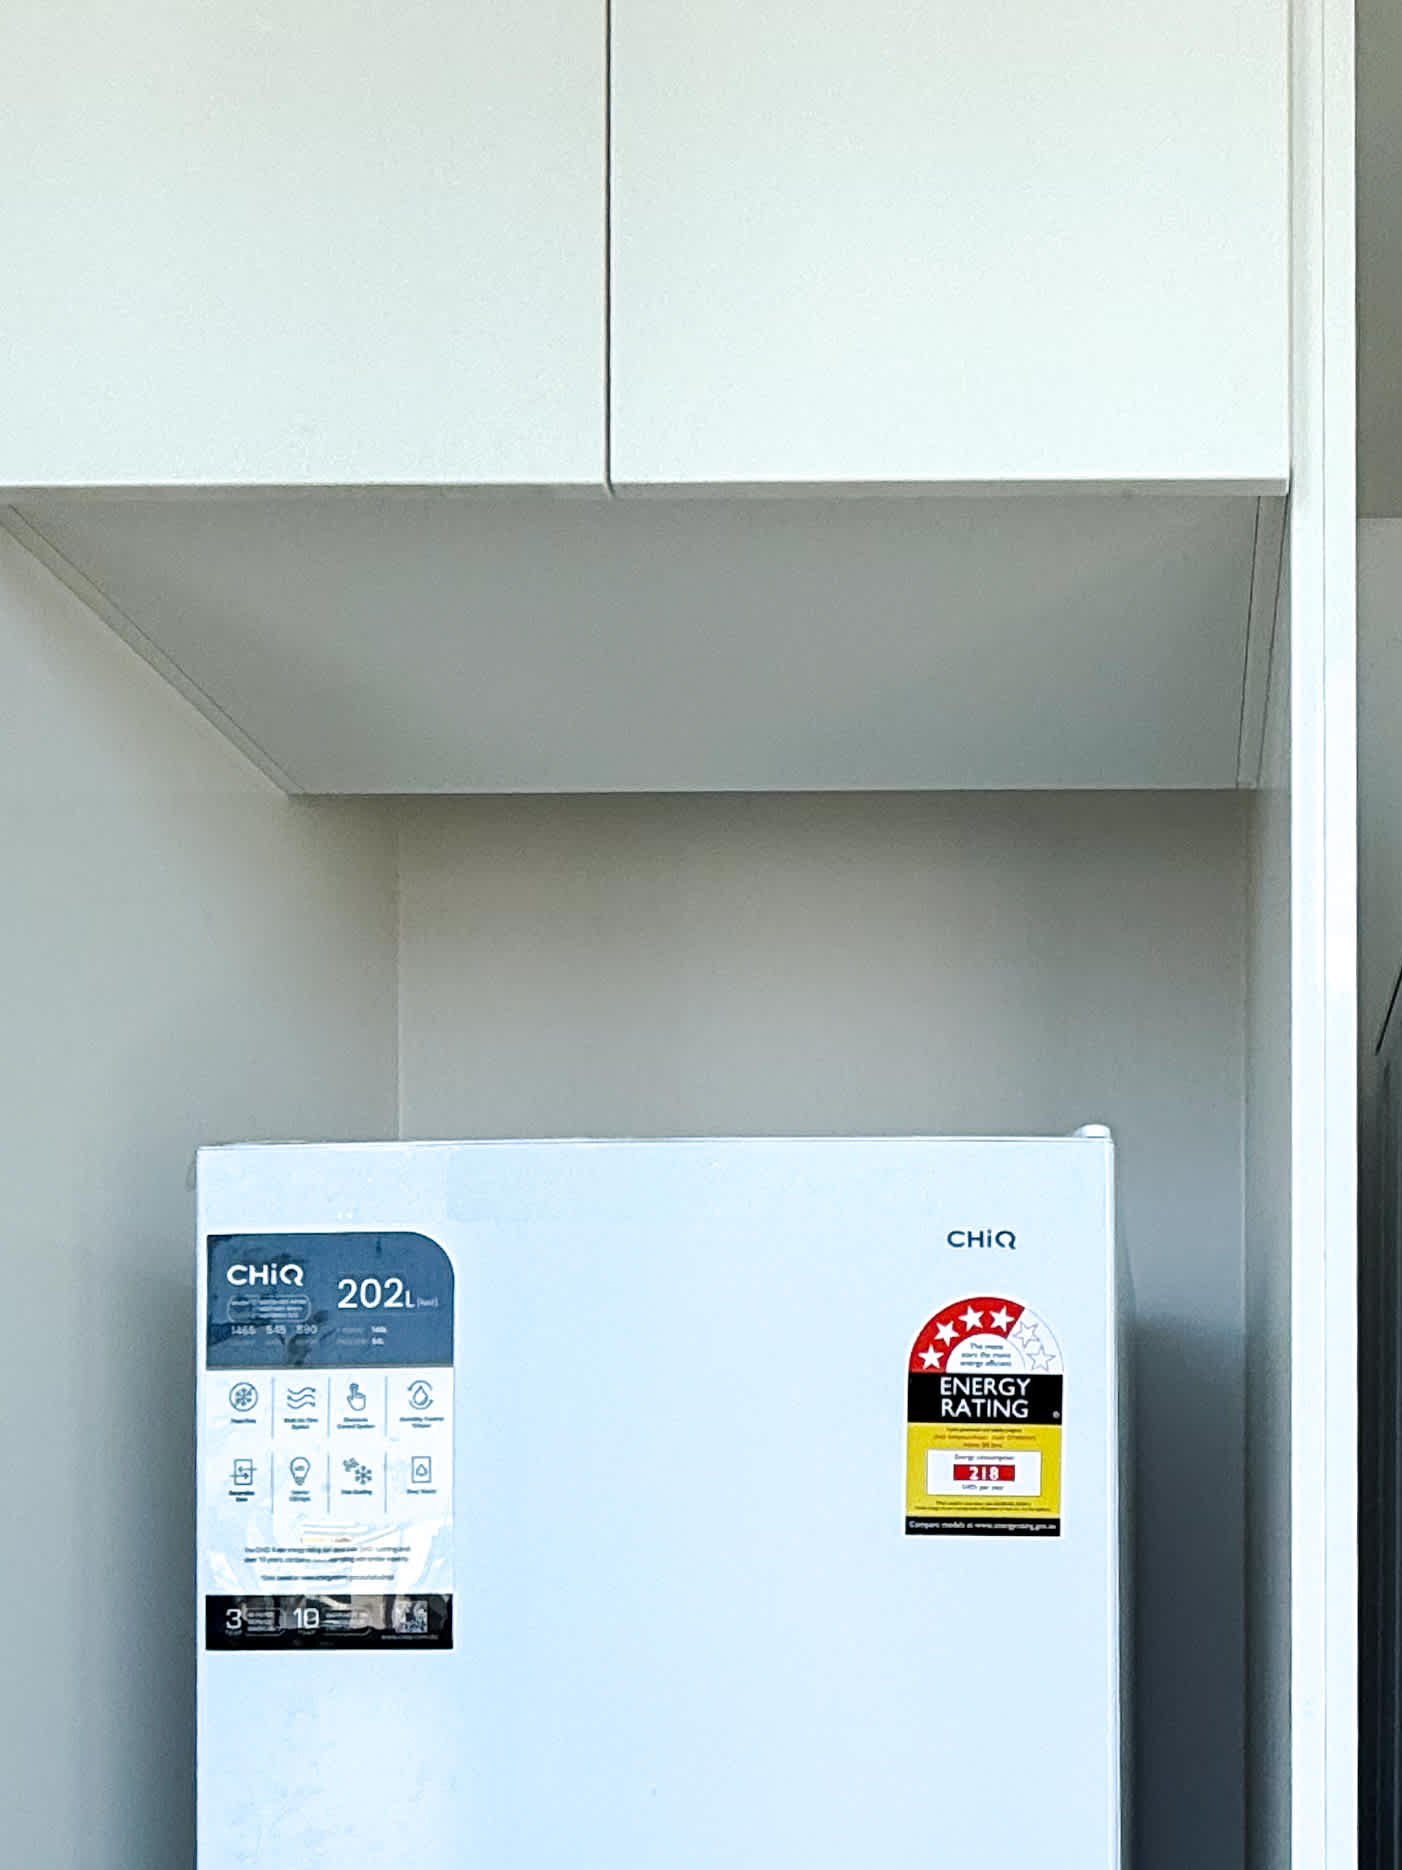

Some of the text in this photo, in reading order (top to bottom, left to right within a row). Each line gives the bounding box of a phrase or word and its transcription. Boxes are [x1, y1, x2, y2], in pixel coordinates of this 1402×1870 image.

[226, 1263, 304, 1287] CHiQ
[940, 1376, 1031, 1396] ENERGY
[941, 1398, 1029, 1418] RATING
[969, 1466, 999, 1480] 218
[226, 1608, 242, 1629] 3
